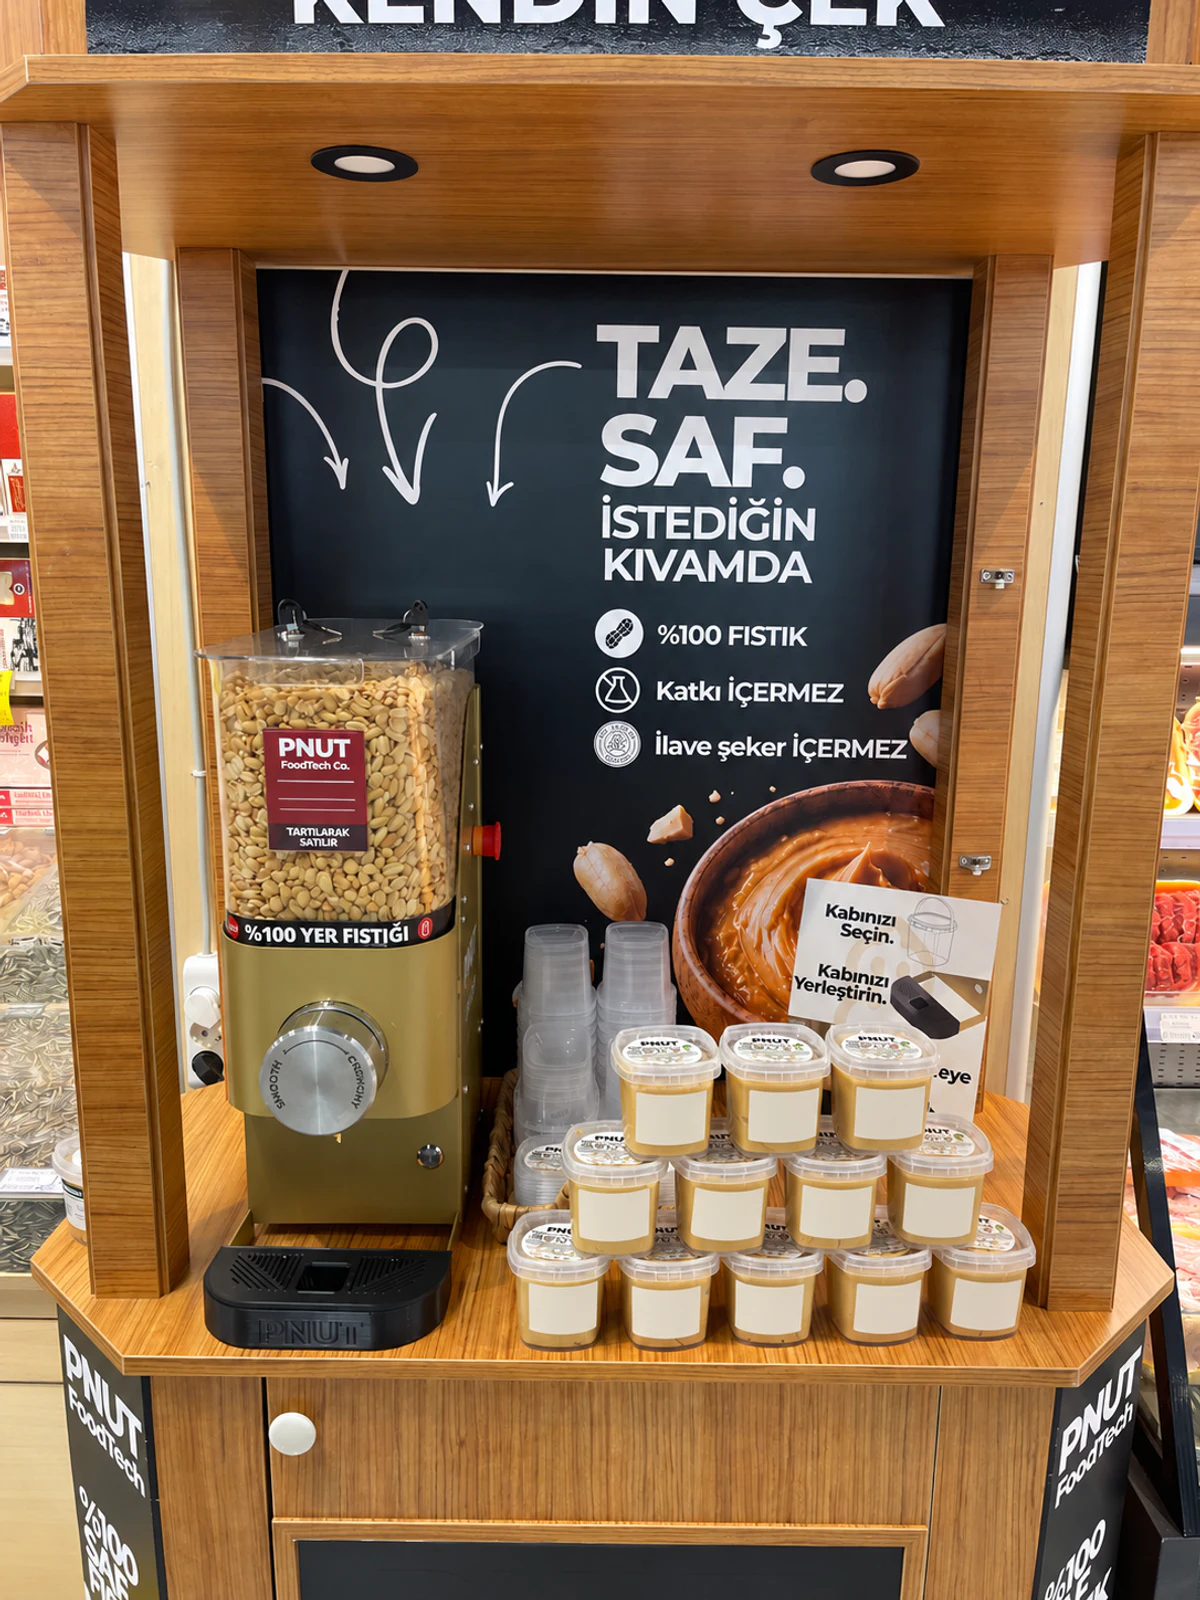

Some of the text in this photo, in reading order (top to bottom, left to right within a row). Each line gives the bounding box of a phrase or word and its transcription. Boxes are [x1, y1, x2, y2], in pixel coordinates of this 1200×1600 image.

[596, 324, 868, 403] TAZE.
[600, 413, 806, 489] SAF.
[602, 494, 816, 541] İSTEDİĞİN
[604, 548, 813, 584] KIVAMDA
[657, 624, 808, 648] %100 FISTIK
[656, 676, 845, 708] Katkı İÇERMEZ
[278, 737, 351, 758] PNUT
[655, 730, 712, 756] İlave
[717, 735, 787, 762] şeker
[792, 732, 909, 764] İÇERMEZ
[281, 760, 351, 771] FoodTech Co.
[286, 826, 351, 837] TARTILARAK
[299, 837, 339, 848] SATILIR
[824, 903, 897, 928] Kabınızı
[244, 923, 297, 943] %100
[301, 927, 339, 944] YER
[840, 923, 895, 944] Seçin.
[793, 975, 888, 1005] Yerleştirin.
[817, 963, 890, 988] Kabınızı
[258, 1318, 364, 1346] PNUT
[63, 1333, 143, 1460] PNUT
[1058, 1344, 1143, 1477] PNUT
[67, 1383, 146, 1498] FoodTech
[1054, 1400, 1134, 1510] FoodTech
[78, 1485, 140, 1587] %100
